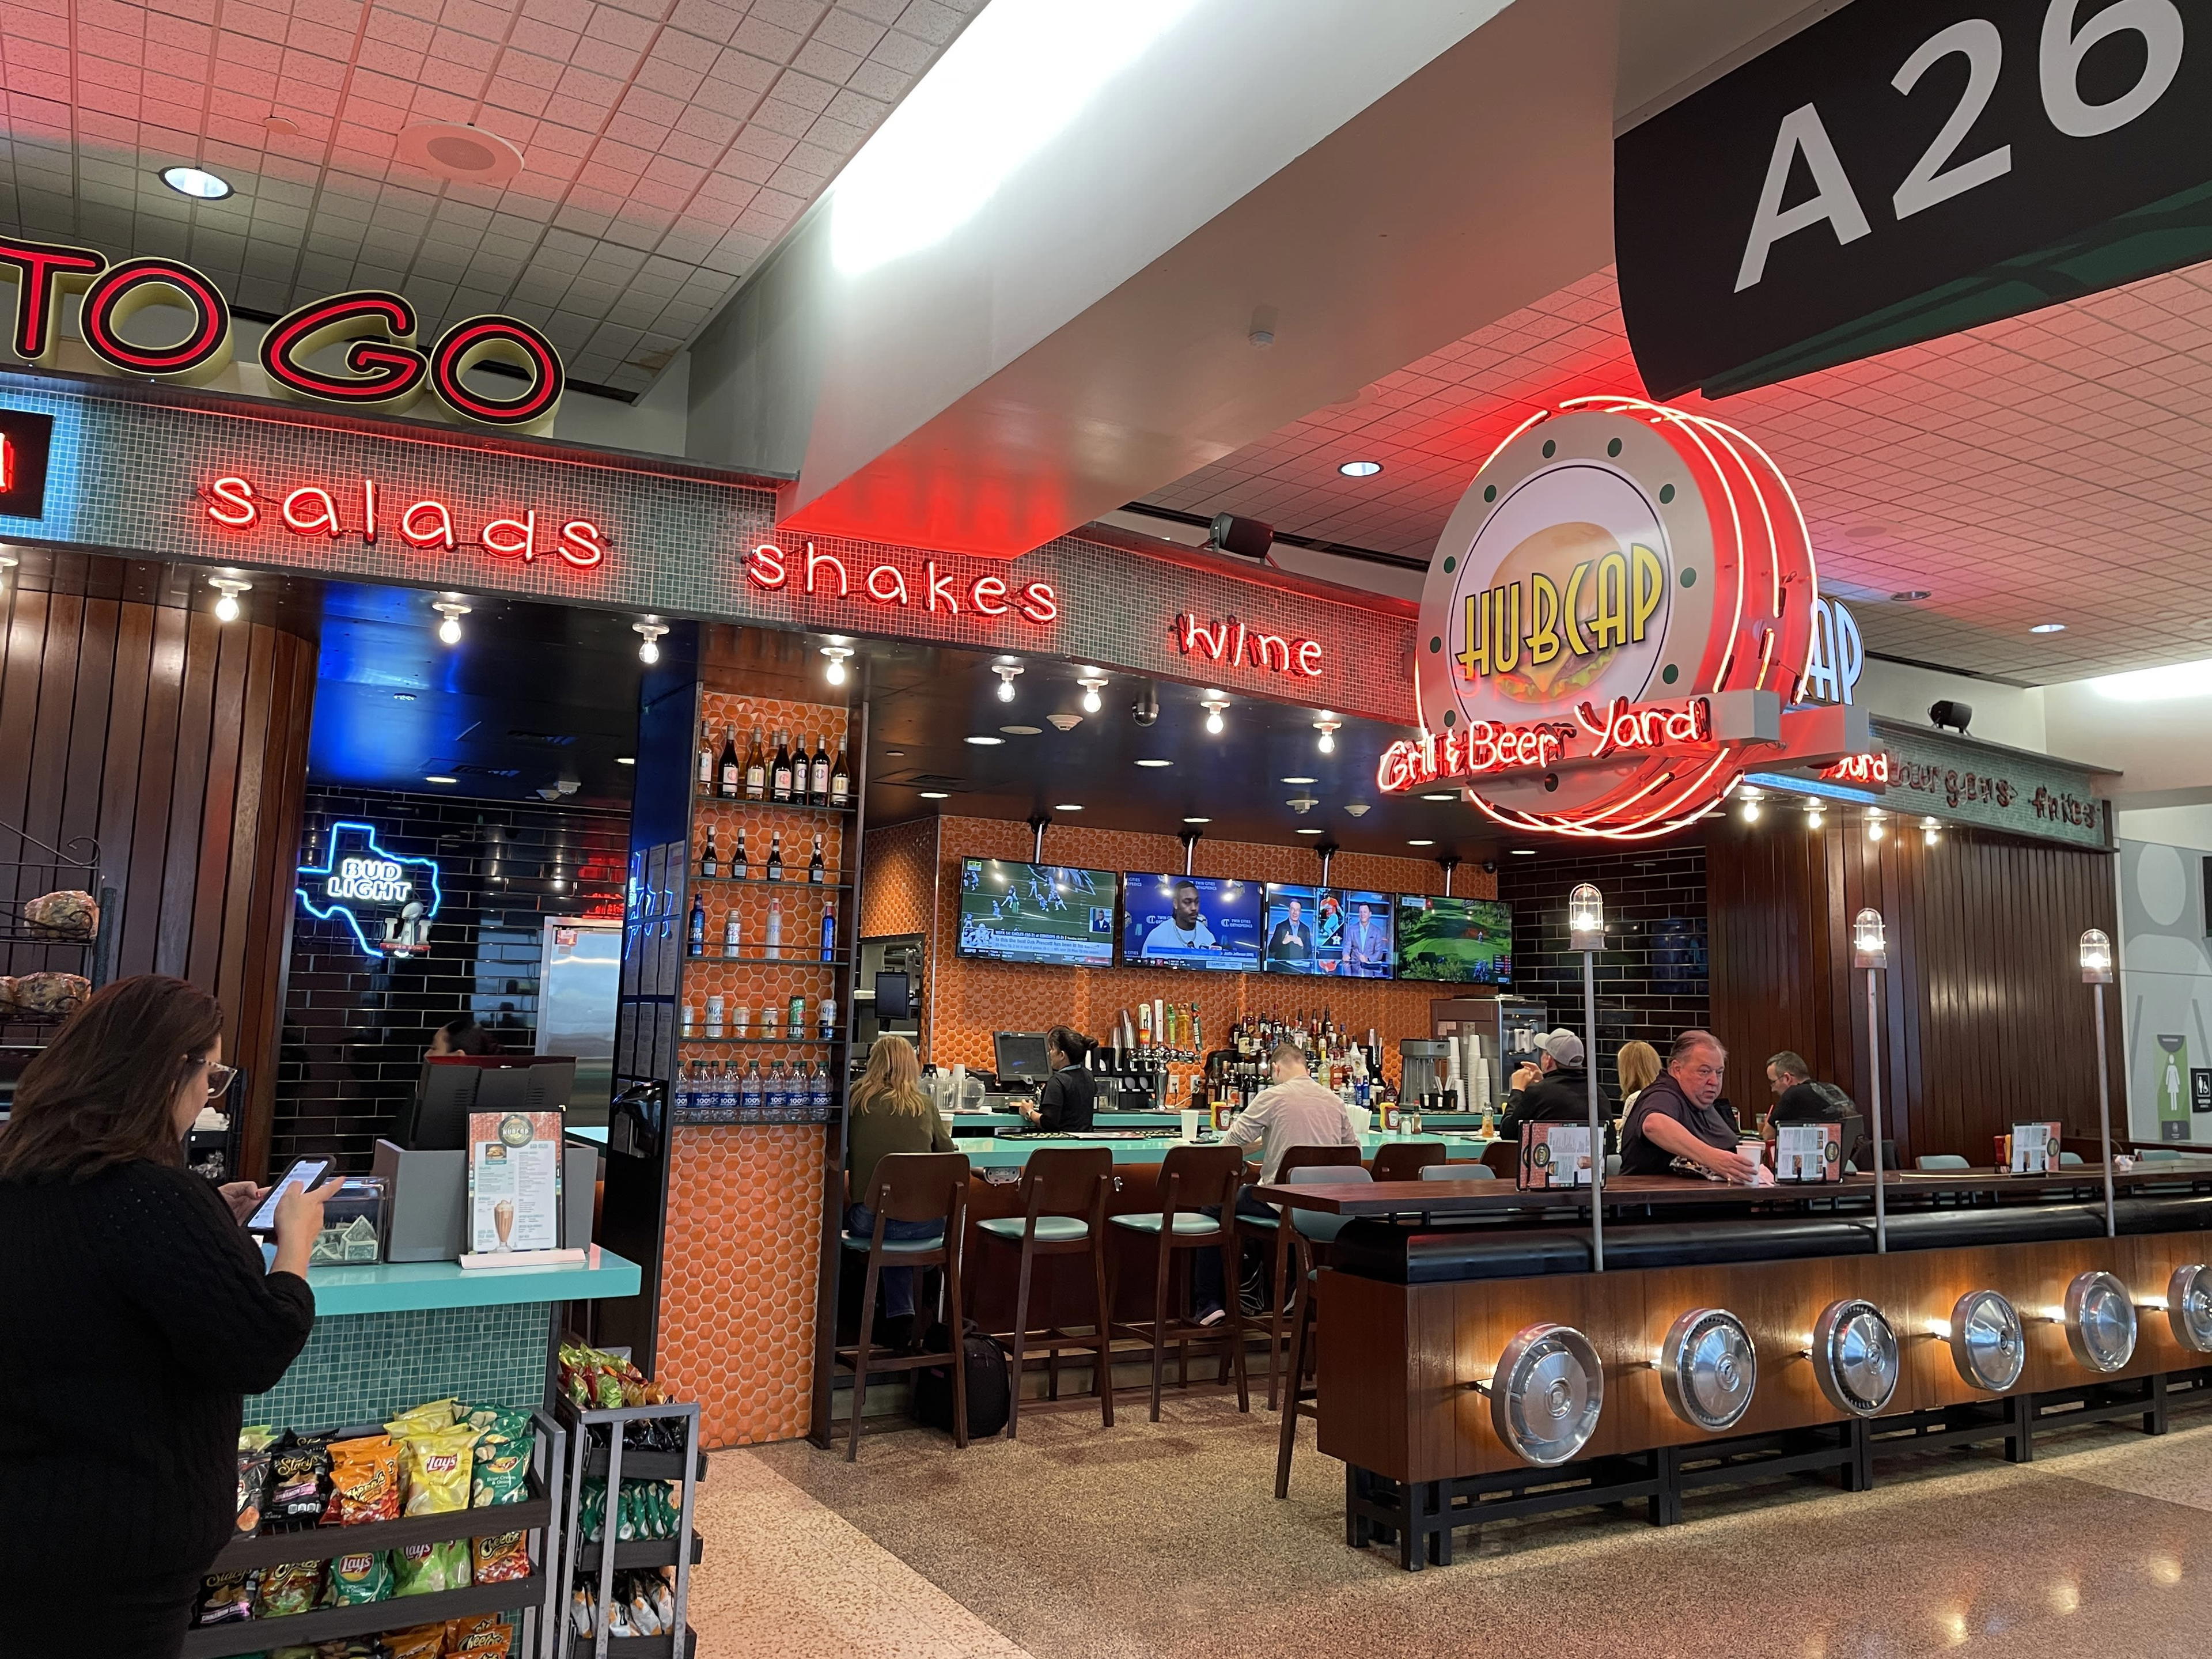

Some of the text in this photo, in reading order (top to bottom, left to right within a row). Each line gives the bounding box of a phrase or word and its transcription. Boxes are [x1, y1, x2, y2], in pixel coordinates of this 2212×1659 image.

[1734, 0, 2184, 293] A26
[0, 237, 565, 427] TO GO
[206, 476, 605, 570] salads
[747, 541, 1059, 624] shakes
[1455, 543, 1663, 680] HUBCAP
[1176, 613, 1323, 677] wine
[1377, 728, 1438, 792] Grill
[1469, 720, 1562, 771] Beer
[1574, 697, 1706, 758] Yard
[327, 877, 412, 902] LIGHT
[342, 858, 402, 881] BUD
[278, 1455, 319, 1476] Stacy's
[426, 1453, 458, 1472] Lay's
[341, 1555, 372, 1573] Lay's
[479, 1530, 521, 1559] Cheetos
